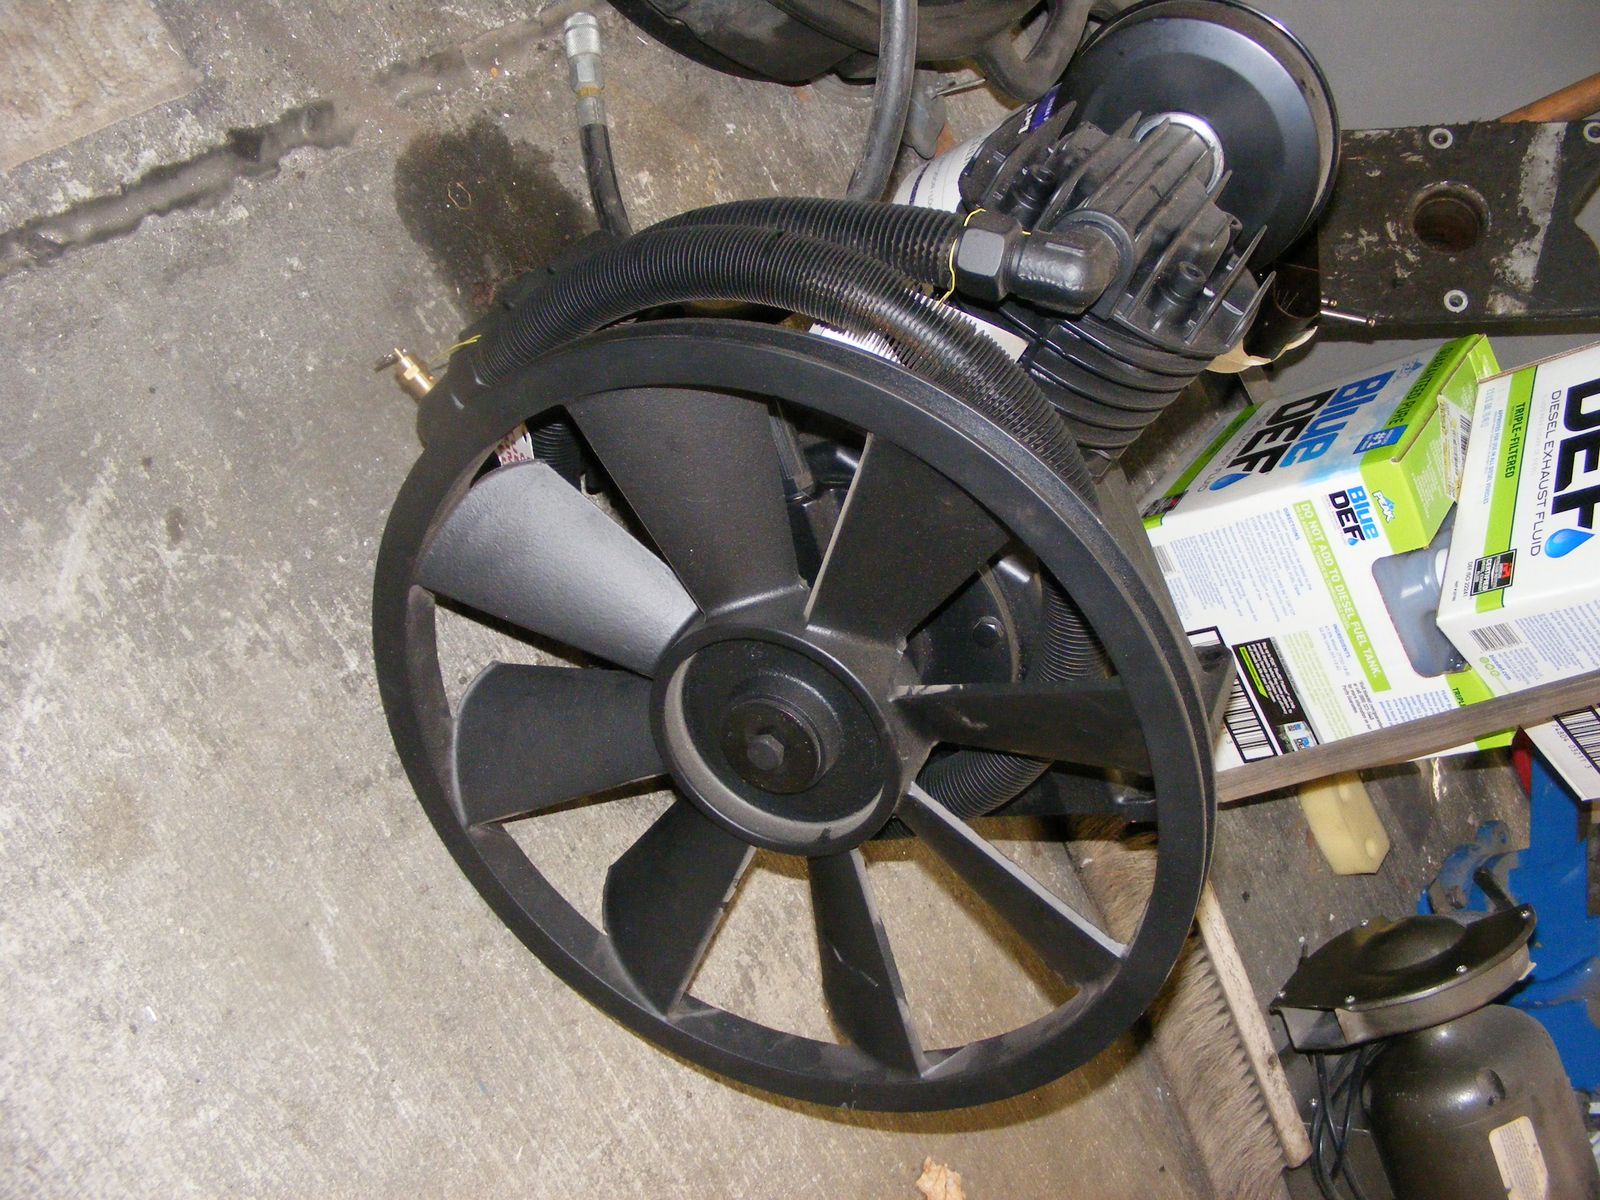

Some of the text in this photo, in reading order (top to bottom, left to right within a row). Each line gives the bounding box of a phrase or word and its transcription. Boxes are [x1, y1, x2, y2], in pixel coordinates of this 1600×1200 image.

[1226, 388, 1337, 473] DEF
[1279, 370, 1396, 468] Blue
[1504, 402, 1526, 479] TRIPLE-FILTERED
[1545, 390, 1561, 439] DIESEL
[1536, 440, 1555, 508] EXHAUST
[1551, 377, 1600, 530] DEF
[1329, 490, 1365, 541] DEF
[1347, 486, 1379, 539] Blue
[1372, 490, 1395, 523] PEAK
[1530, 512, 1546, 557] FLUID
[1301, 503, 1381, 677] DO NOT ADD TO DIESEL FUEL TANK.
[1483, 559, 1492, 591] CERTIFIED
